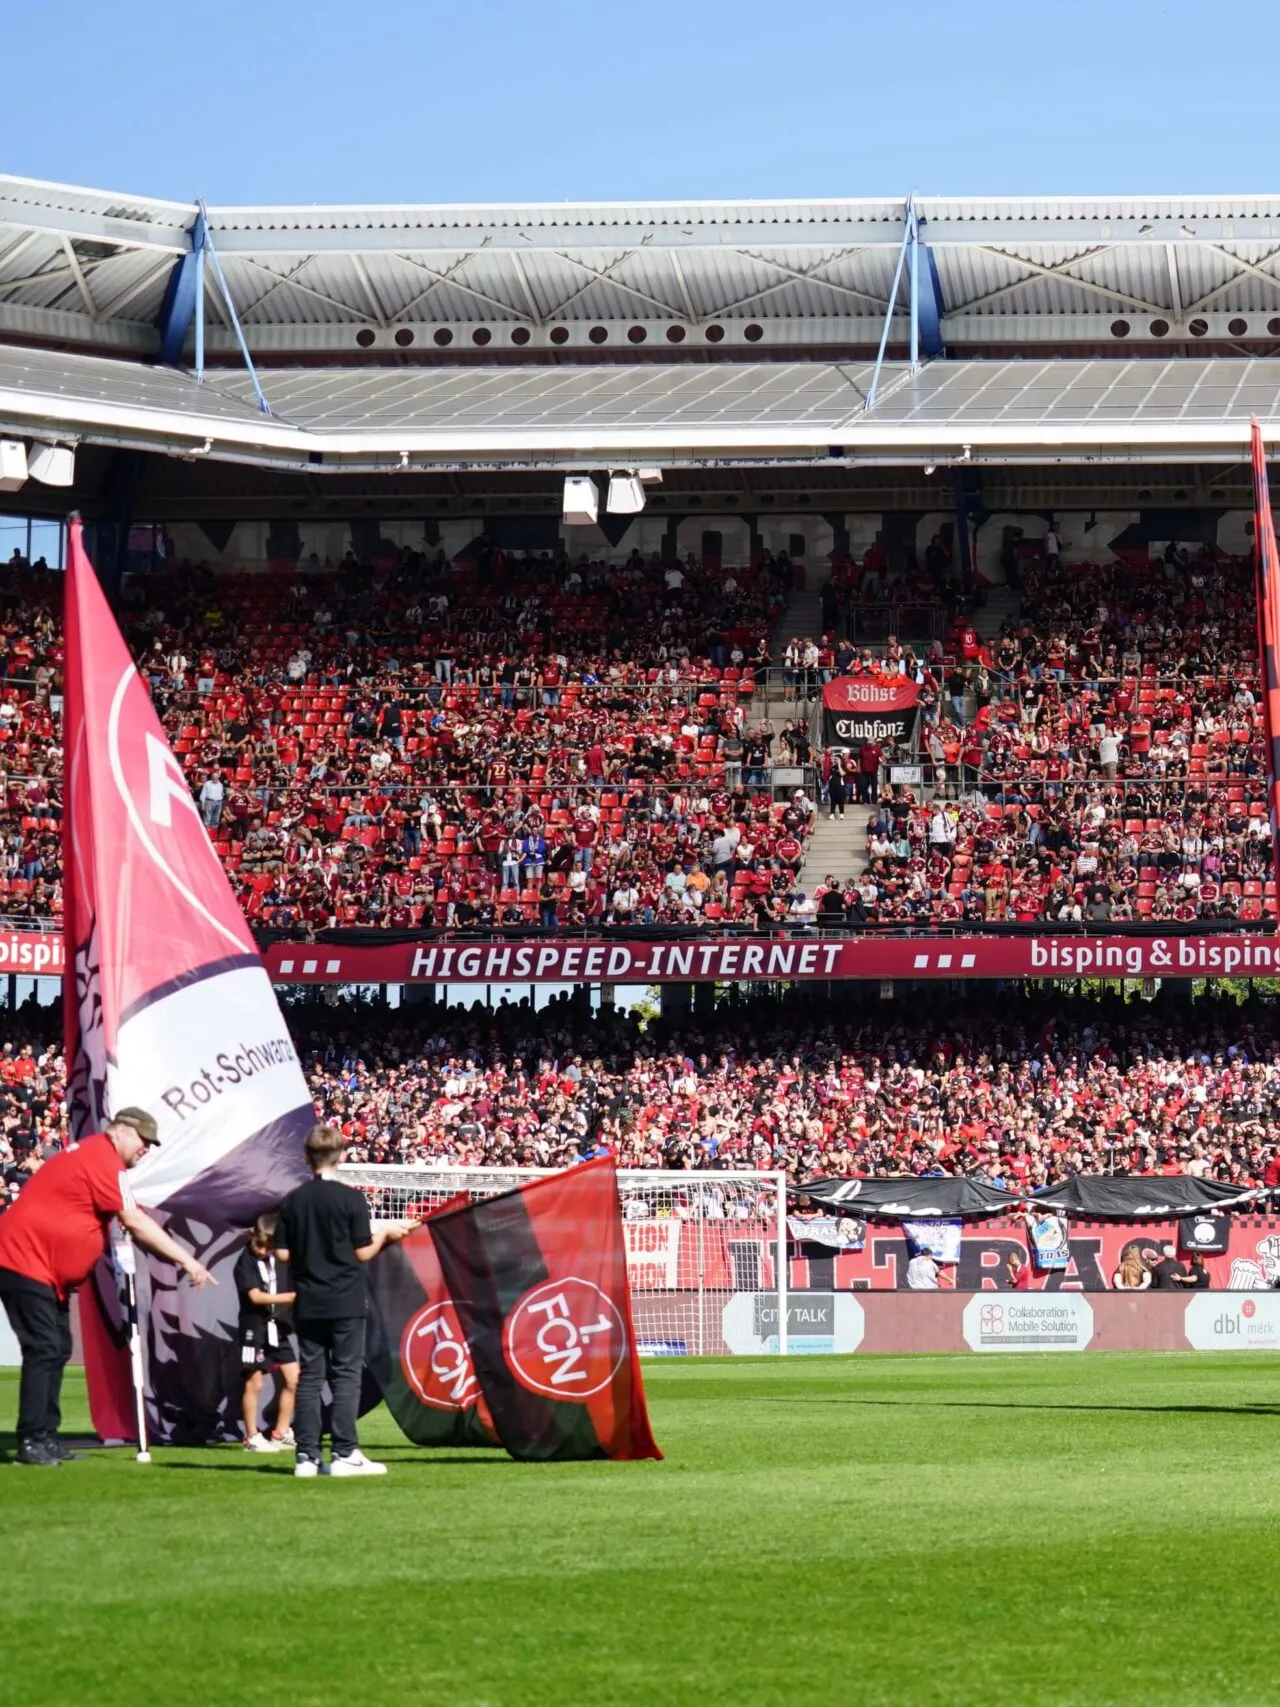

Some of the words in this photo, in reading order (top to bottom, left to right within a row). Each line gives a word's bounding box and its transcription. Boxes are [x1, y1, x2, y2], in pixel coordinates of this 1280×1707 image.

[846, 683, 898, 703] Böhse
[836, 719, 906, 740] Clubfanz
[411, 944, 843, 977] HIGHSPEED-INTERNET
[1031, 939, 1143, 973] bisping
[1149, 939, 1173, 966] &
[795, 1308, 826, 1322] TALK
[1008, 1306, 1068, 1318] Collaboration
[580, 1313, 613, 1345] 1.
[1008, 1320, 1039, 1332] Mobile
[1041, 1320, 1078, 1332] Solution
[1214, 1313, 1240, 1334] dbl
[527, 1293, 589, 1385] FCN
